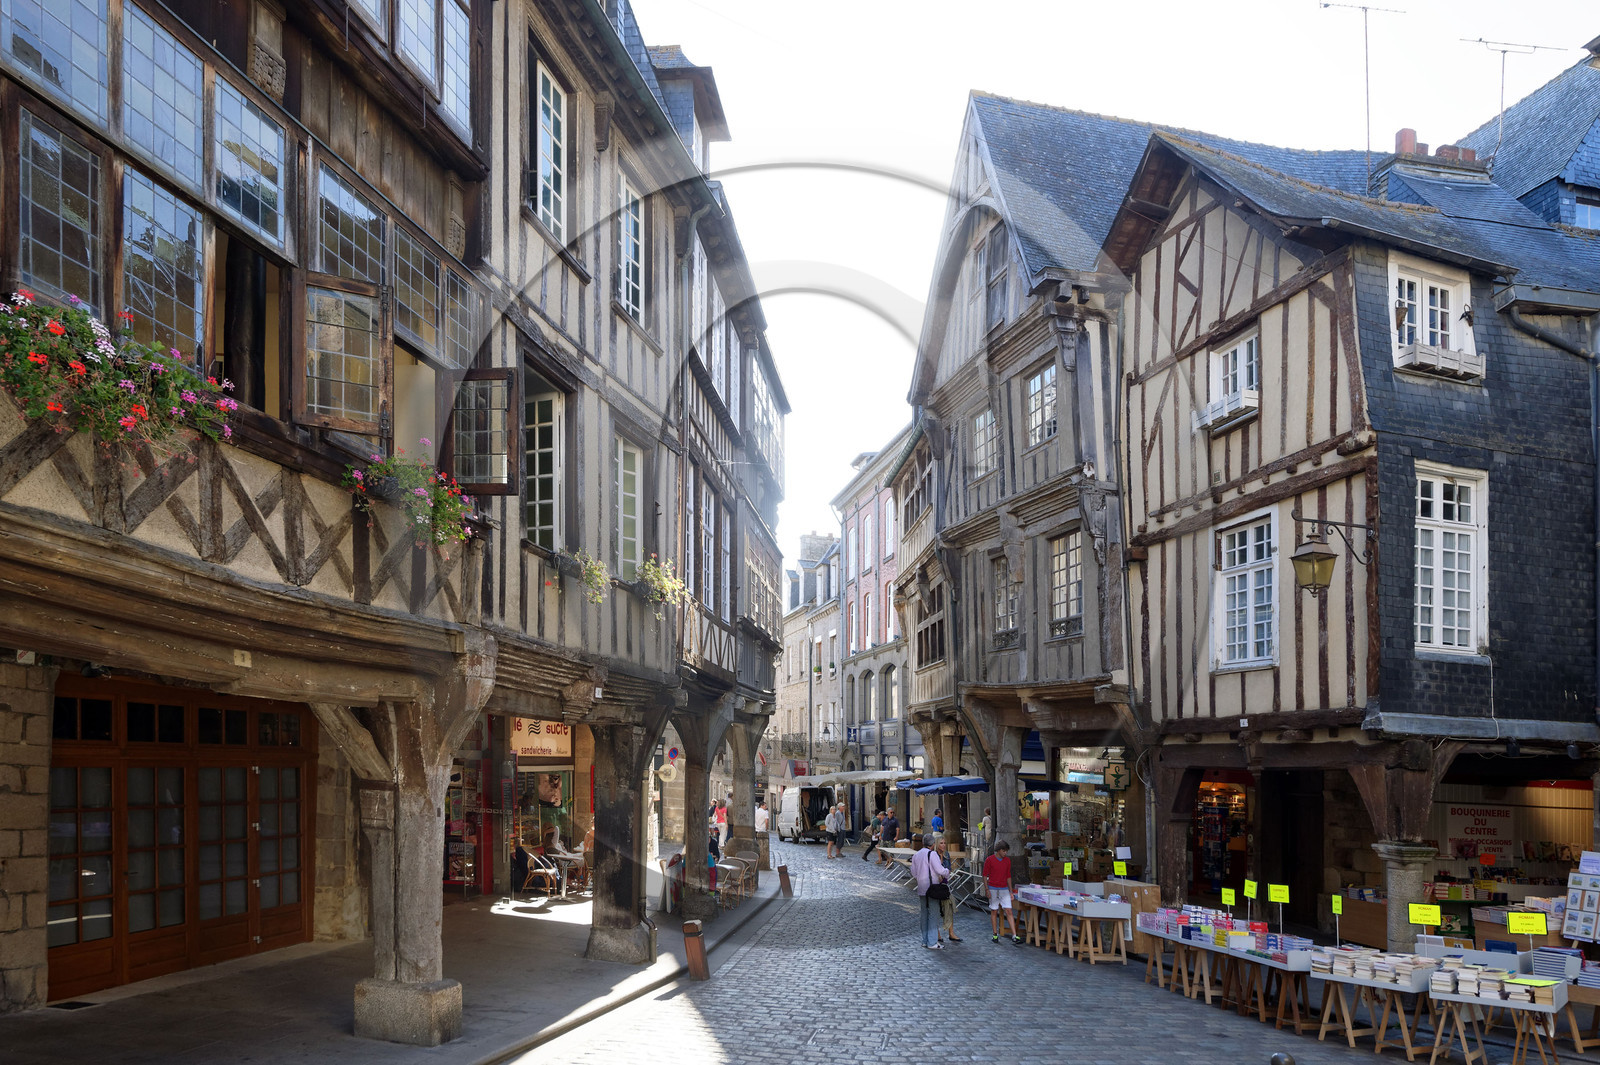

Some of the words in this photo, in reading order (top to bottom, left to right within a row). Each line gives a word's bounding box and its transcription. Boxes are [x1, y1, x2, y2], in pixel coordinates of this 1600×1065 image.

[521, 746, 552, 755] sandwicherie
[1451, 808, 1510, 817] BOUQUINERIE
[1464, 827, 1497, 835] CENTRE
